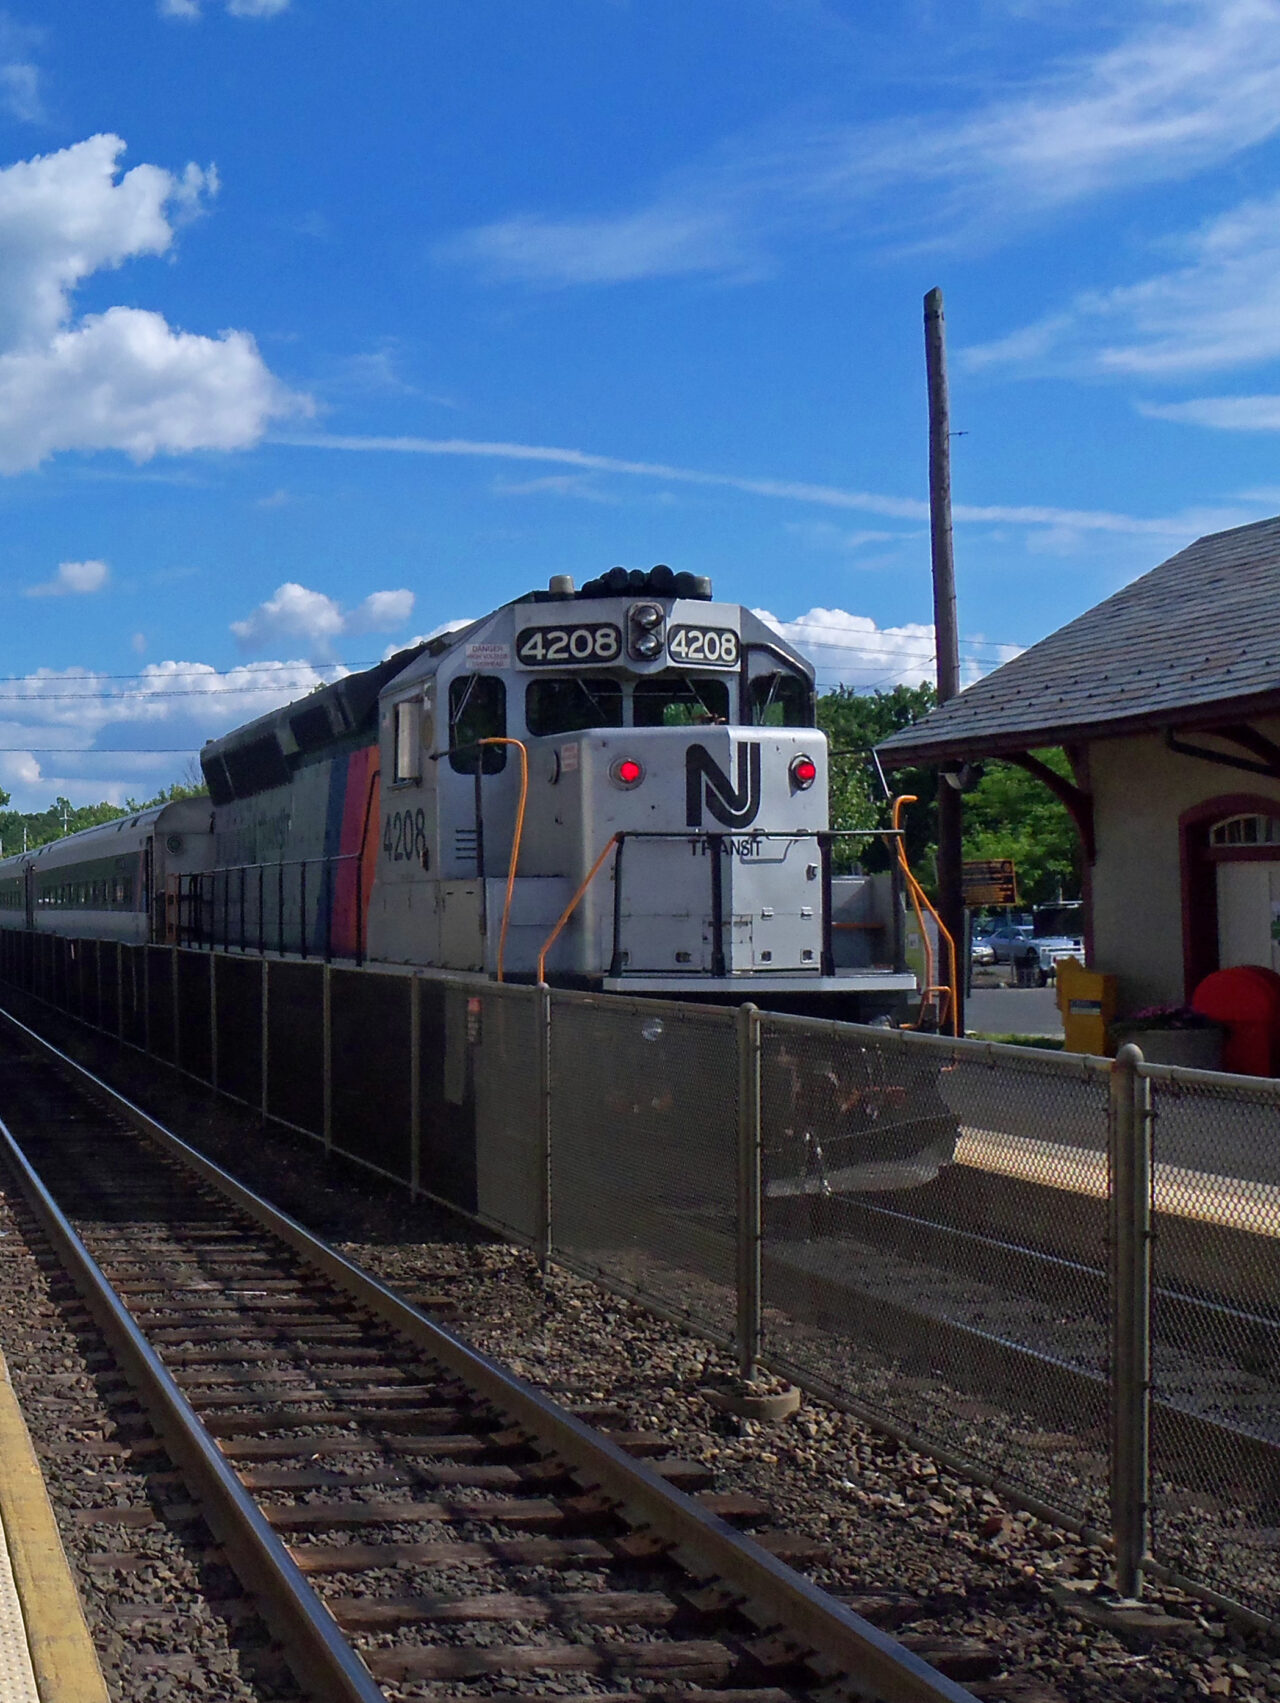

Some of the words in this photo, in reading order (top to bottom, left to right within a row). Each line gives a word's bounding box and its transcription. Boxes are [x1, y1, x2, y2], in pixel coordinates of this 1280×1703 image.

[520, 627, 618, 661] 4208
[669, 629, 737, 662] 4208
[383, 808, 426, 863] 4208
